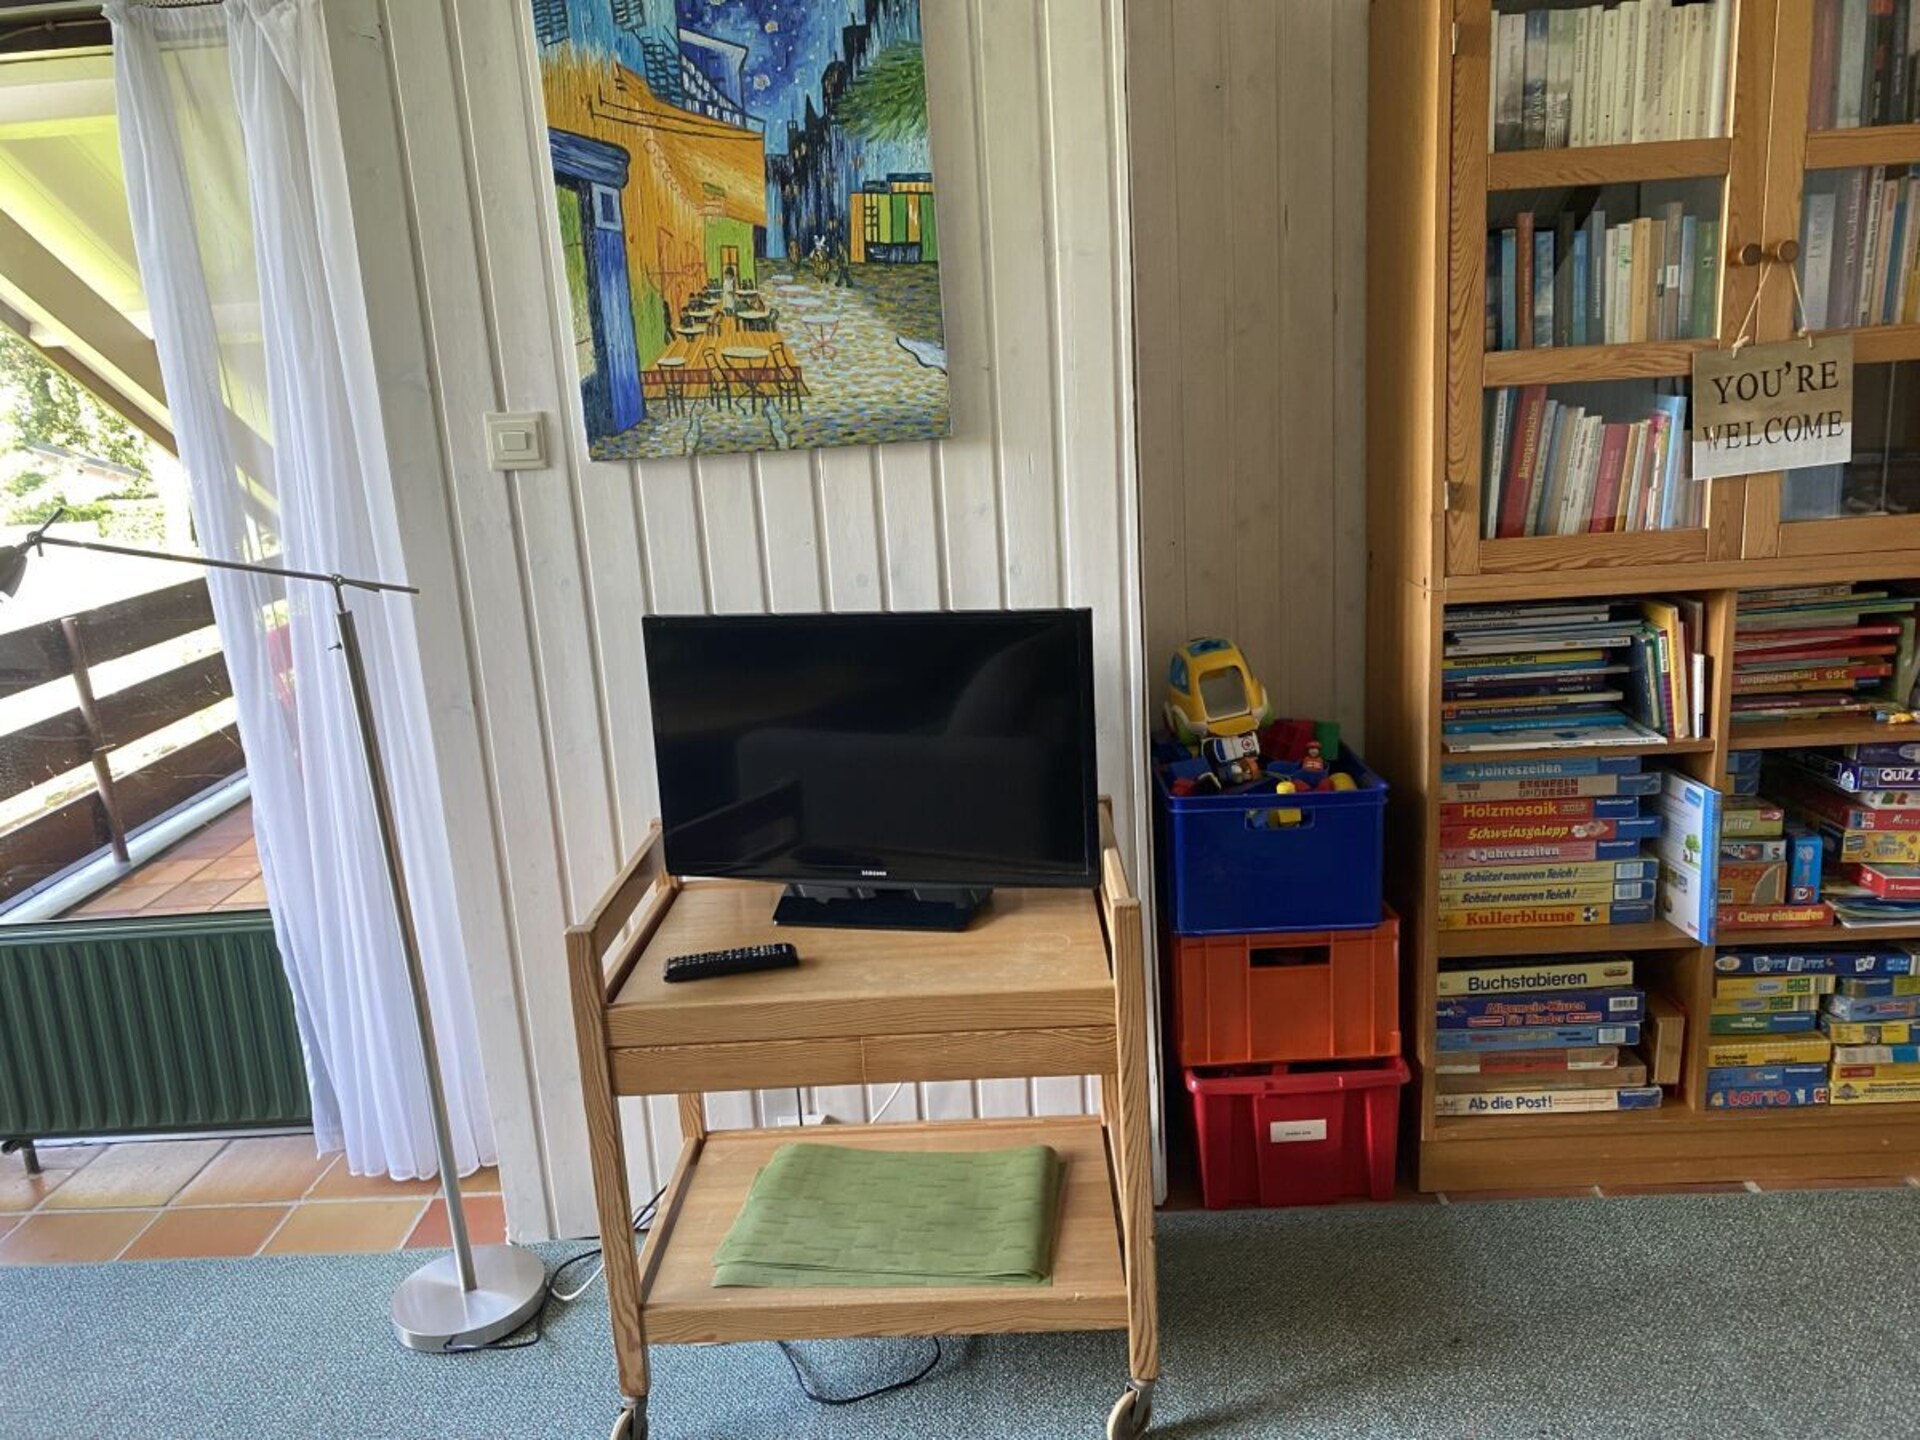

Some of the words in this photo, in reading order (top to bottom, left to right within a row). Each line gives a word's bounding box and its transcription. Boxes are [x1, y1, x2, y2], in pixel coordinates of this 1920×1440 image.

[1711, 361, 1839, 405] YOU'RE
[1703, 410, 1844, 451] WELCOME
[1478, 763, 1563, 778] Jahreszeiten
[1463, 801, 1558, 818] Holzmosaik
[1467, 825, 1569, 841] Schweinsgalopp
[1481, 846, 1560, 861] Jahreszeiten
[1462, 869, 1502, 883] Schützt
[1503, 870, 1546, 881] unseren
[1546, 867, 1579, 879] Teich!
[1461, 891, 1502, 904] Schützt
[1502, 890, 1545, 902] unseren
[1545, 888, 1577, 900] Teich!
[1465, 909, 1576, 926] Kullerblume
[1737, 911, 1770, 922] Clever
[1772, 909, 1825, 921] einkaufen
[1467, 972, 1588, 991] Buchstabieren
[1468, 1097, 1489, 1111] Ab
[1490, 1096, 1513, 1110] die
[1516, 1095, 1553, 1109] Post!
[1728, 1088, 1792, 1106] LOTTO
